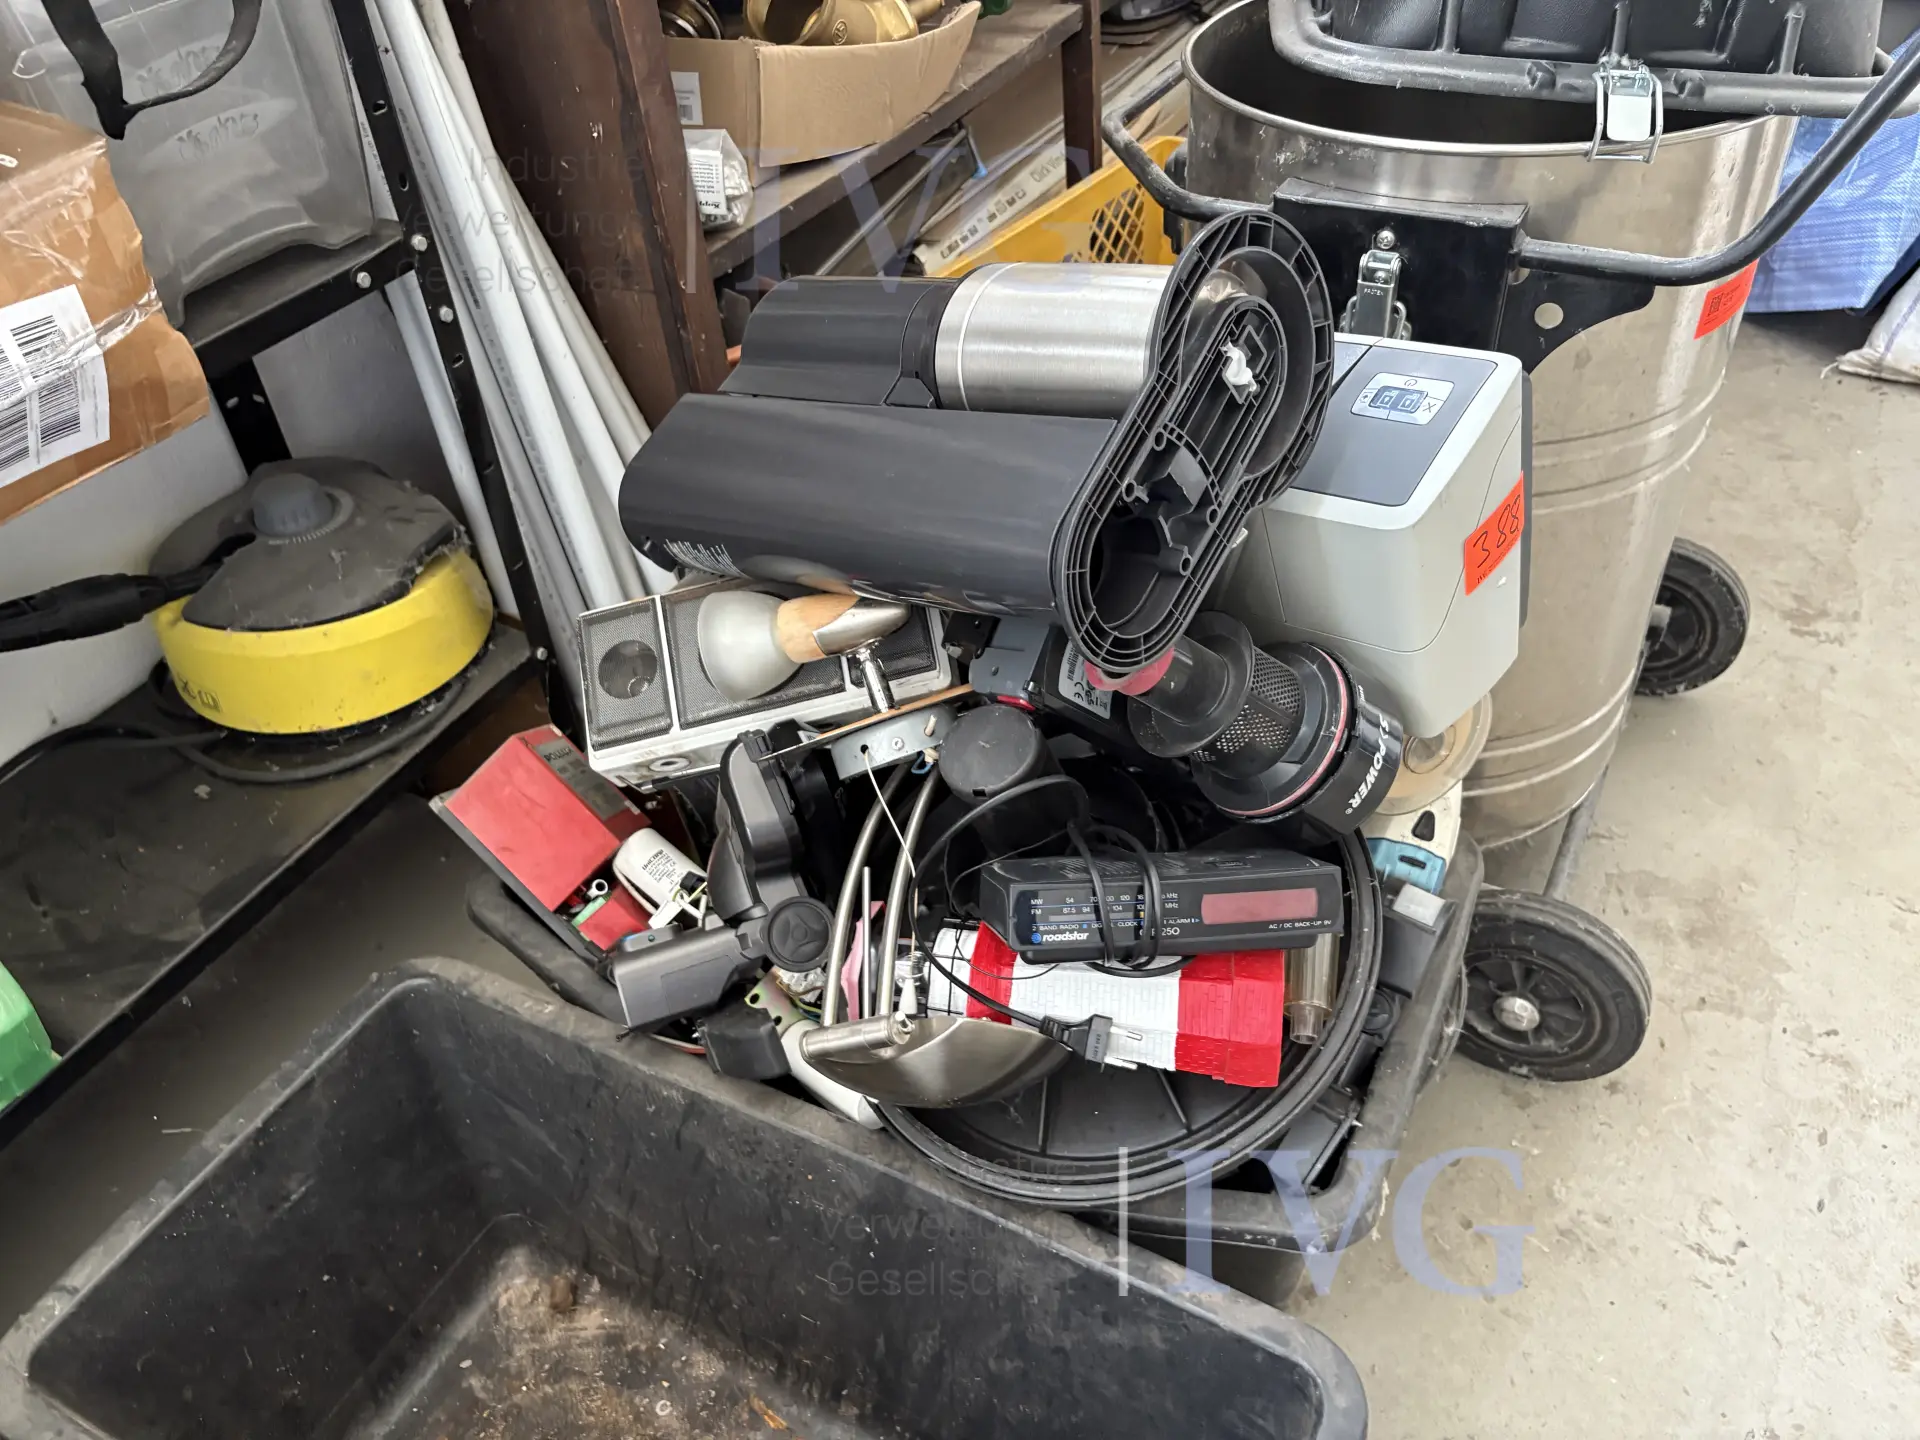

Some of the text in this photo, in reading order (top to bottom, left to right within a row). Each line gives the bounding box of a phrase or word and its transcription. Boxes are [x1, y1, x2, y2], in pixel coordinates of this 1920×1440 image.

[1473, 494, 1521, 568] 388
[1062, 906, 1076, 914] 87.5
[1042, 931, 1089, 941] roadstar
[1161, 927, 1180, 936] 250
